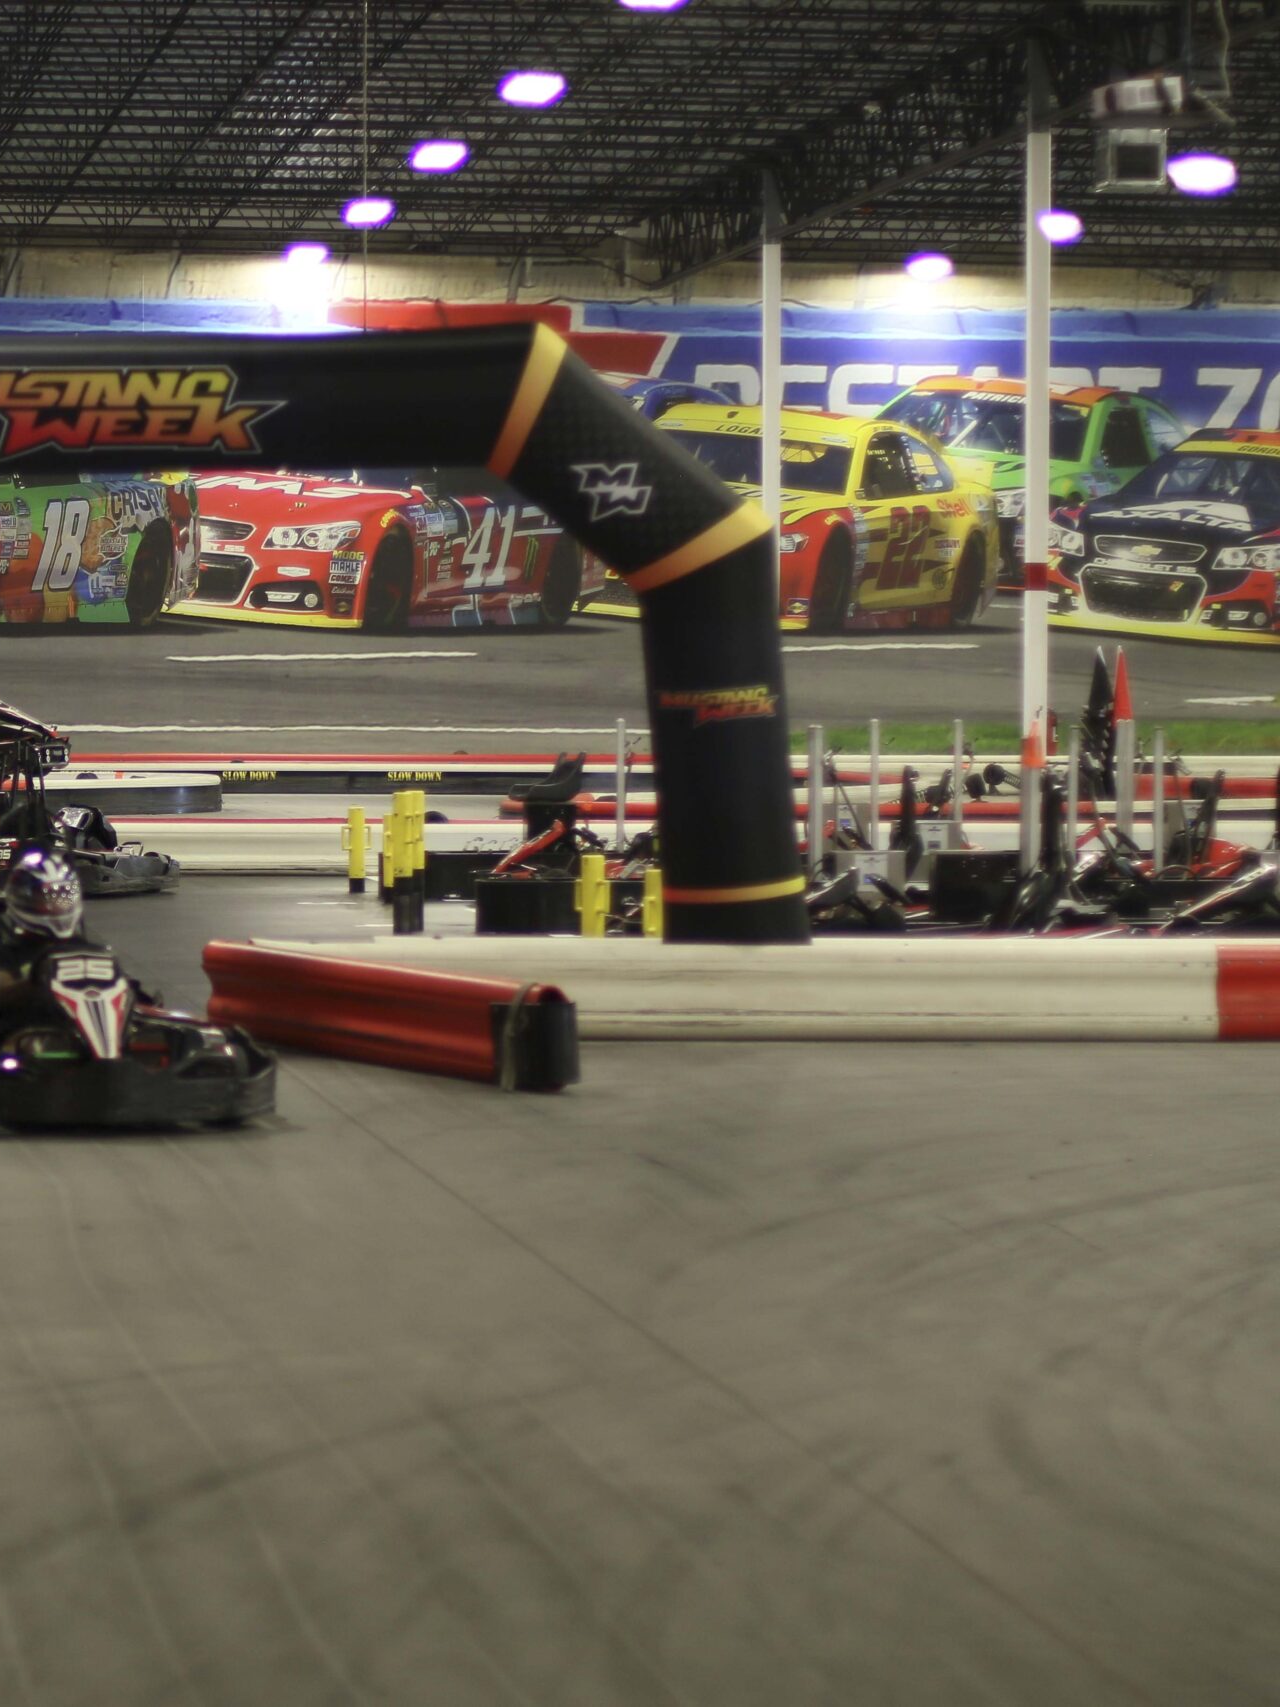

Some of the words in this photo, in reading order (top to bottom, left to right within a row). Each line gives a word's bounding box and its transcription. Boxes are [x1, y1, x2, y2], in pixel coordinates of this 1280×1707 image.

[5, 402, 258, 454] WEEK
[1089, 510, 1253, 532] AXALTA
[31, 499, 90, 592] 18
[332, 551, 365, 561] MOOG
[462, 505, 516, 589] 41
[875, 504, 931, 591] 22
[330, 561, 361, 573] MAHLE
[222, 771, 246, 781] SLOW
[249, 770, 277, 781] DOWN
[387, 771, 412, 781] SLOW
[415, 771, 442, 782] DOWN
[56, 958, 114, 981] 25
